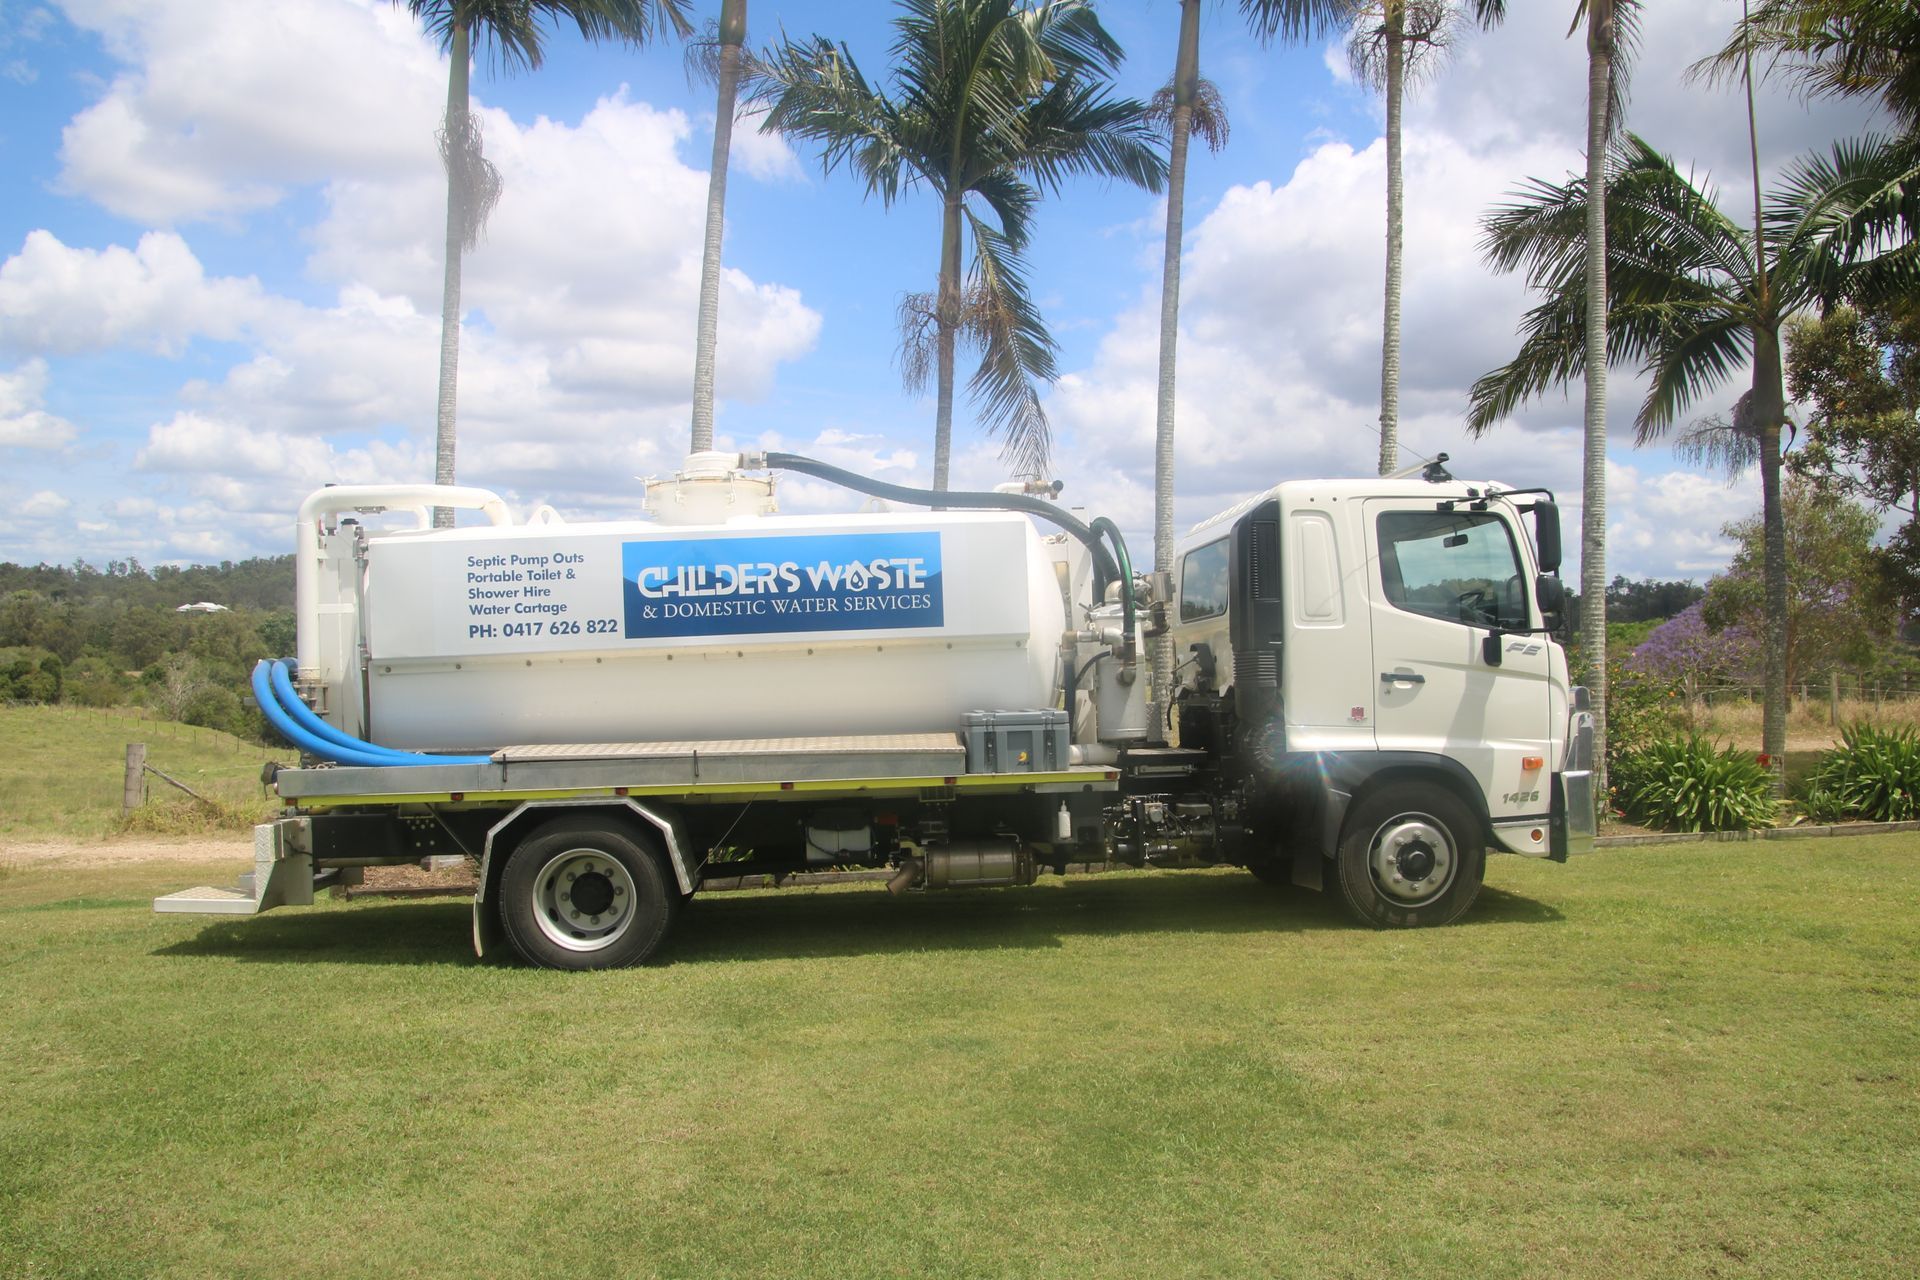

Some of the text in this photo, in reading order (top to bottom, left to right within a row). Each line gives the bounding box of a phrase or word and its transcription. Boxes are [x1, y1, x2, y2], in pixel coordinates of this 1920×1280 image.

[467, 552, 584, 570] Septic Pump Outs
[467, 568, 576, 583] Portable Toilet &
[637, 558, 928, 599] CHILDERS WASTE
[468, 586, 551, 600] Shower Hire
[469, 602, 568, 616] Water Cartage
[642, 594, 931, 619] & DOMESTIC WATER SERVICES
[469, 619, 618, 639] PH: 0417 626 822
[1502, 790, 1539, 804] 1426
